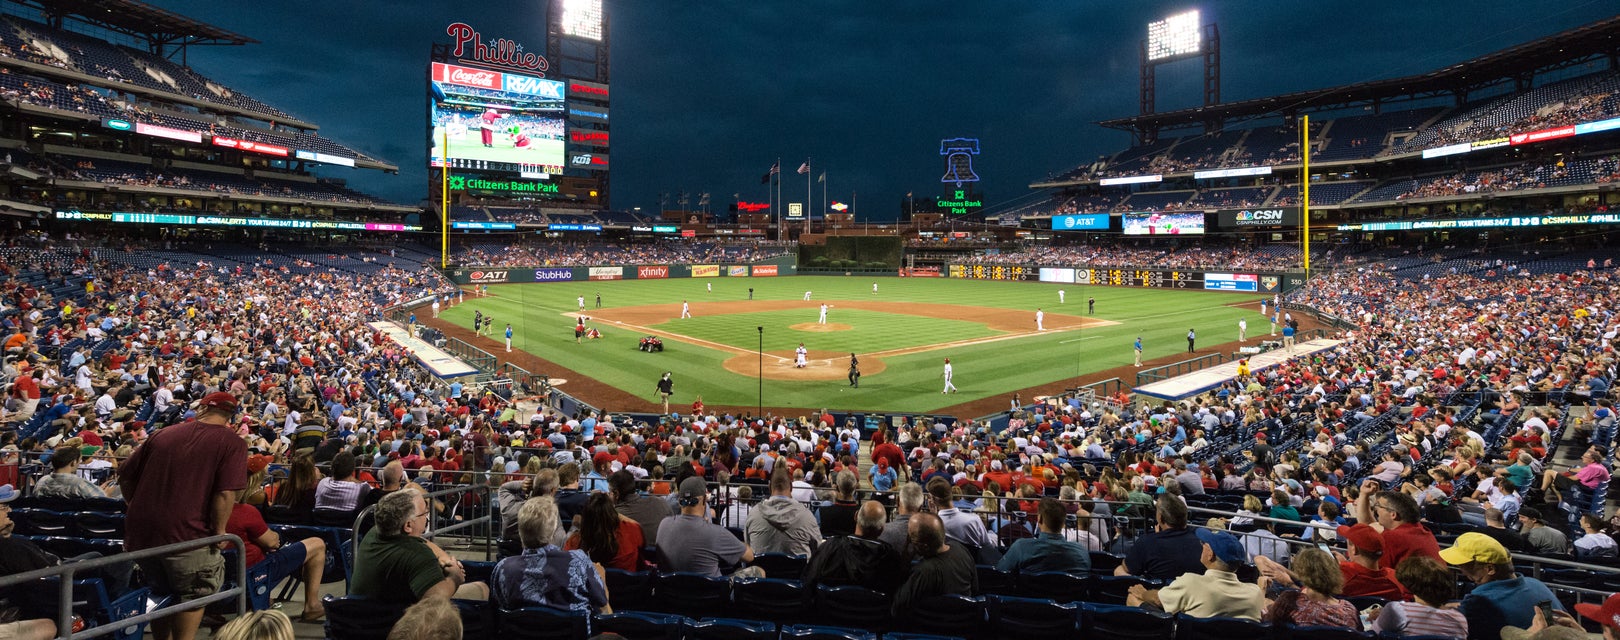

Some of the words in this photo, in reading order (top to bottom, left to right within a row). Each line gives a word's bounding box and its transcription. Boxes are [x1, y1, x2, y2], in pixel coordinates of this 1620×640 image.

[447, 22, 549, 72] Phillies
[452, 68, 495, 87] Coca-Cola
[507, 75, 560, 97] RE/MAX
[467, 179, 509, 190] Citizens
[511, 181, 535, 192] Bank
[537, 183, 559, 193] Park
[1253, 209, 1284, 220] CSN
[1542, 216, 1589, 225] @CSNPHILLY
[1076, 218, 1095, 226] AT&T
[483, 271, 508, 280] ATI
[535, 270, 572, 280] StubHub
[640, 265, 667, 278] xfinity
